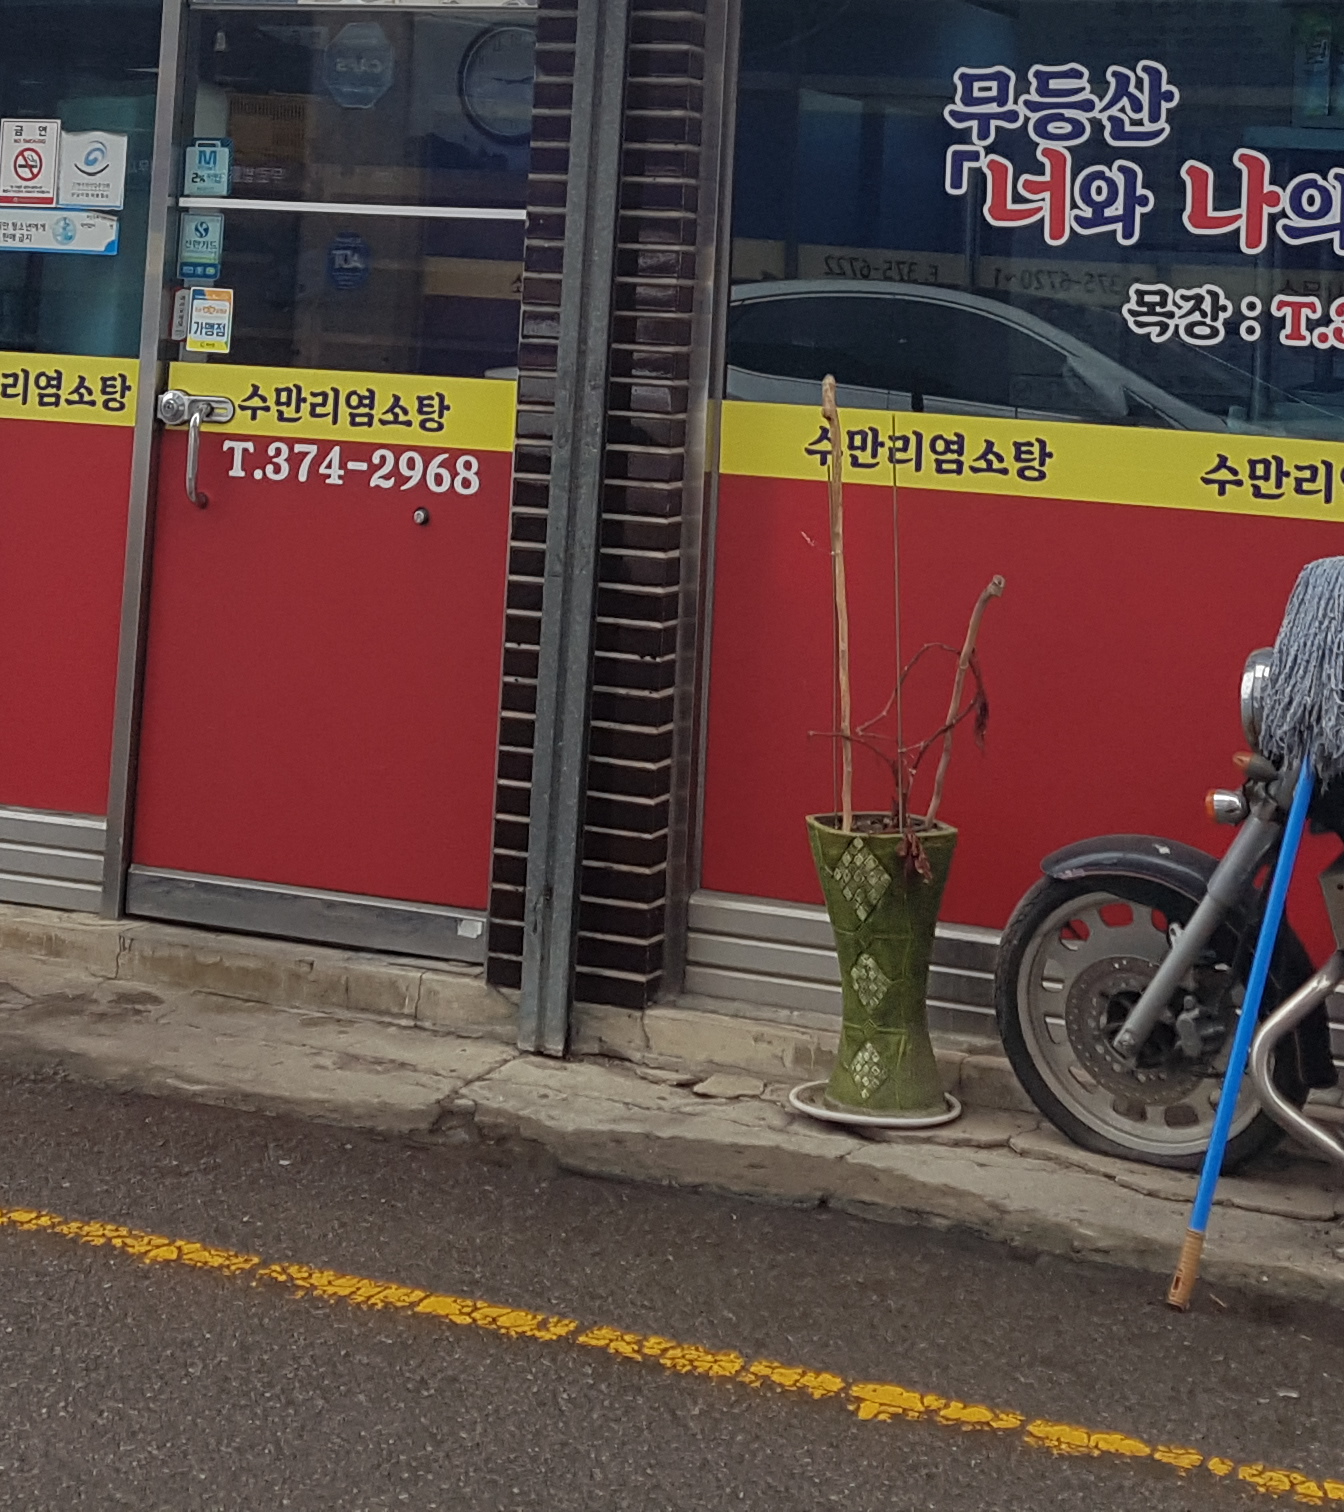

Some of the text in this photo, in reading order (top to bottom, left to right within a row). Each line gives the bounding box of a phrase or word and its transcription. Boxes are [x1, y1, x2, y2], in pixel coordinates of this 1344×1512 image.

[945, 60, 1179, 148] 무등산
[192, 320, 227, 338] 가맹점
[237, 384, 452, 435] 수만리염소탕
[222, 439, 482, 498] T.374-2968
[805, 424, 1054, 483] 수만리염소탕
